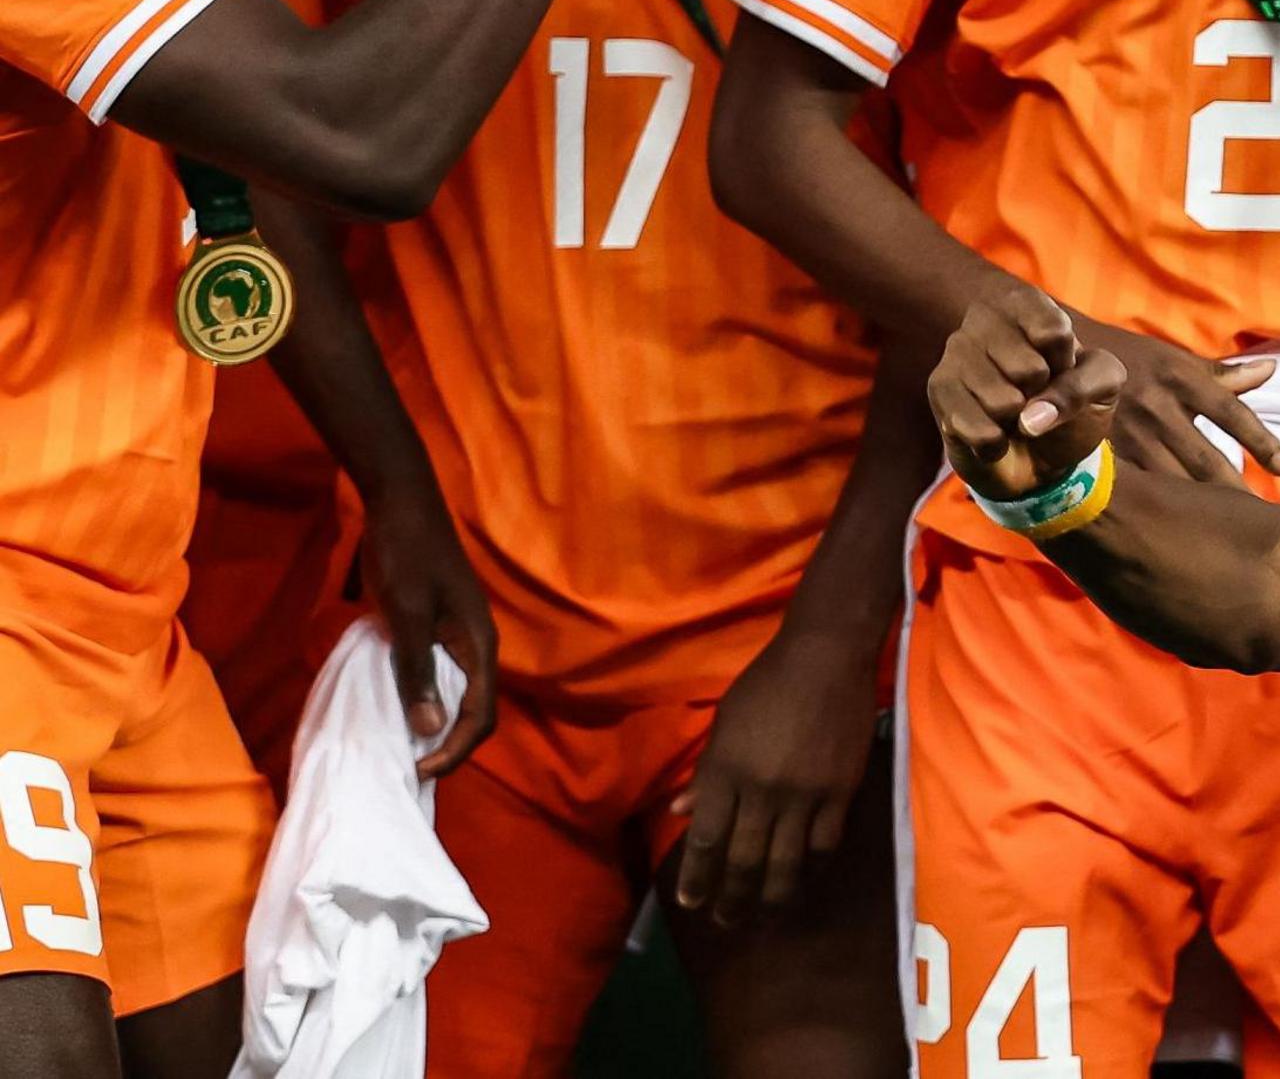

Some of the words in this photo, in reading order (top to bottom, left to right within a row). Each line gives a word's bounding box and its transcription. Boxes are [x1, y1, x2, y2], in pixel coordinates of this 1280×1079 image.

[548, 35, 695, 250] 17
[209, 320, 269, 343] CAF
[0, 750, 103, 957] 9
